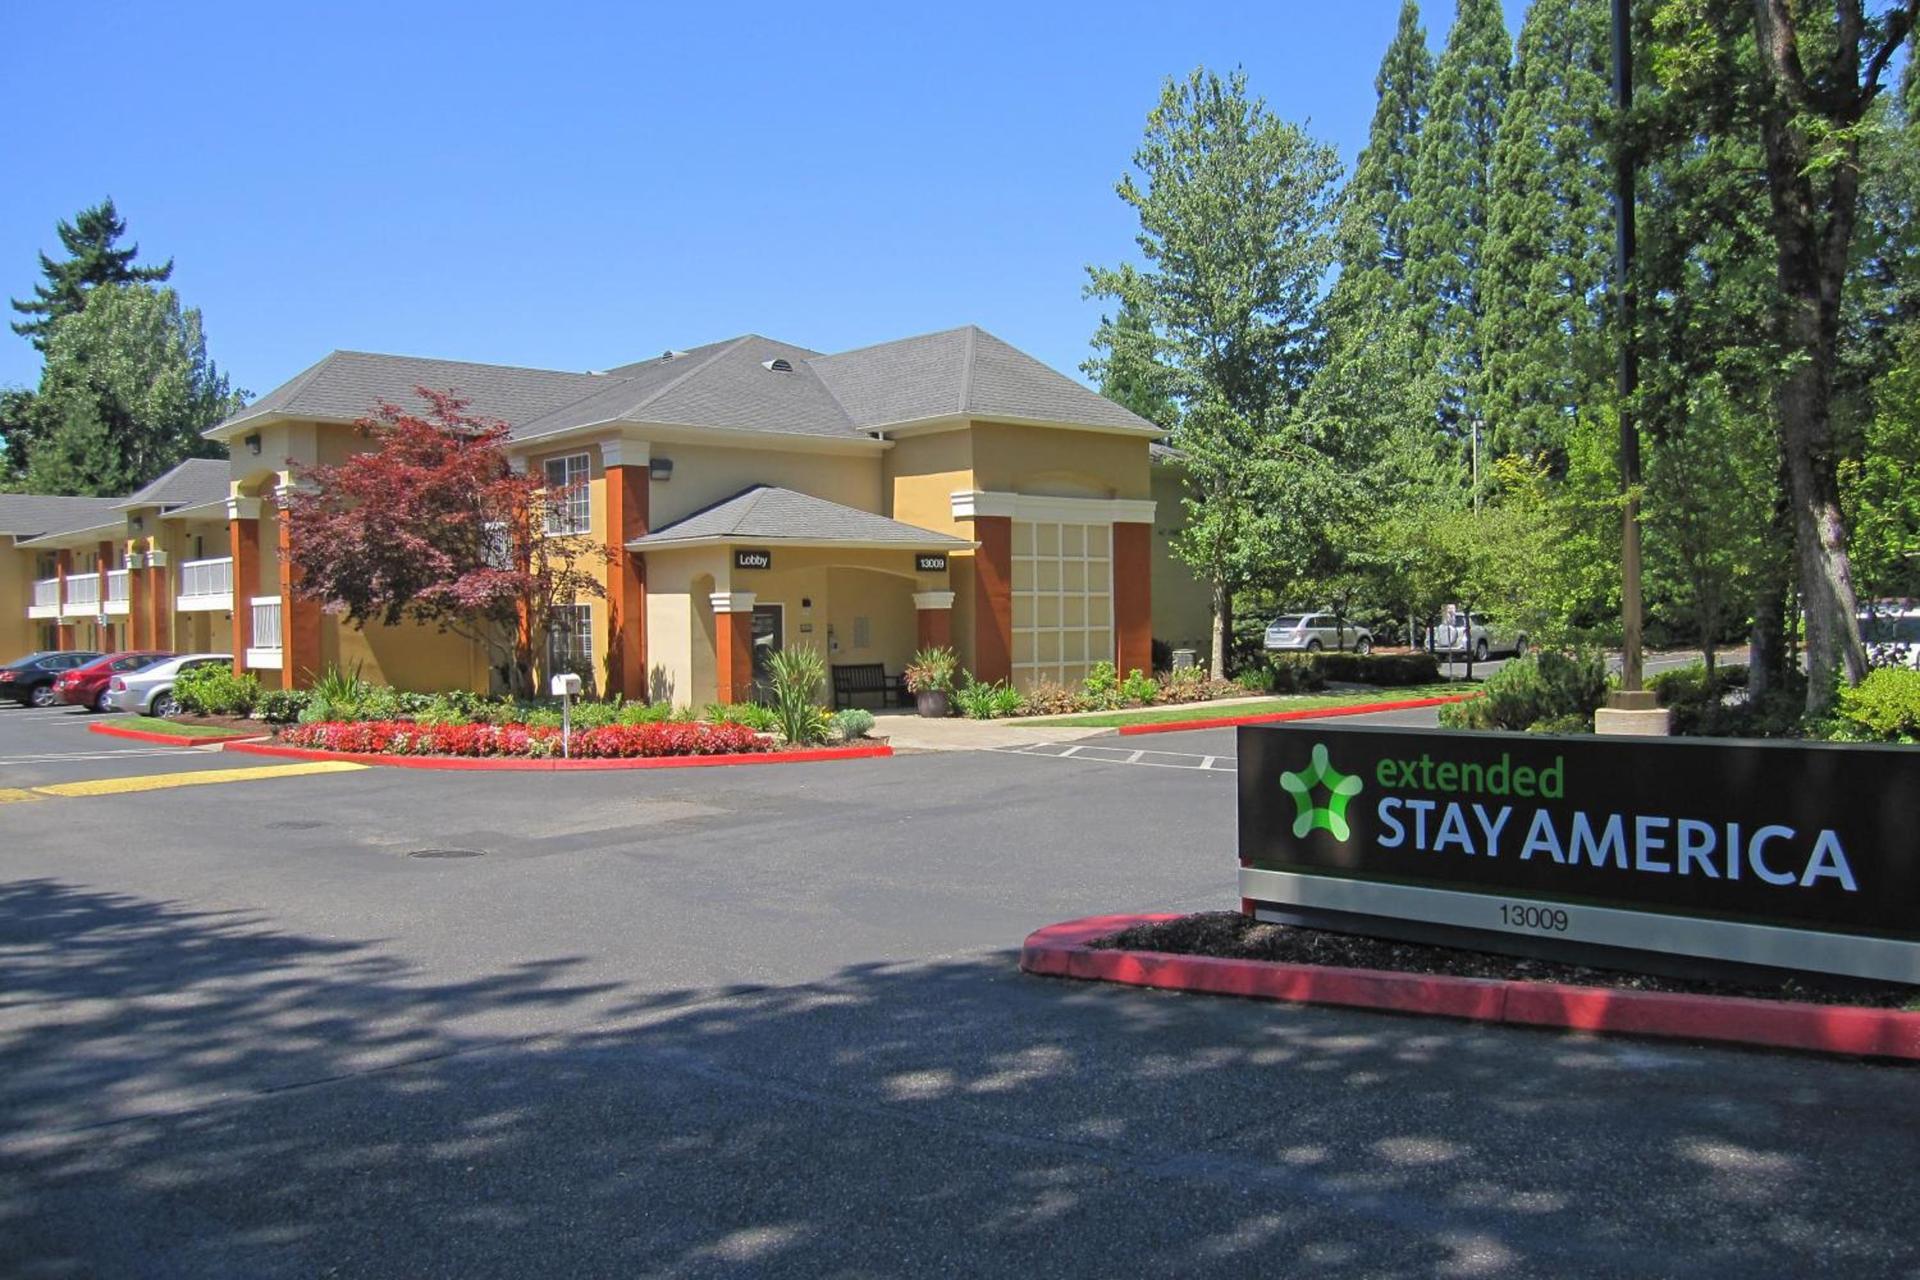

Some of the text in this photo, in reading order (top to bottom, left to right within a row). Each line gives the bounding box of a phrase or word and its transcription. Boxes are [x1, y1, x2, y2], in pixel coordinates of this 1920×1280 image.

[740, 553, 768, 568] Lobby
[920, 558, 944, 569] 13009
[1376, 753, 1564, 798] extended
[1376, 797, 1859, 891] STAY AMERICA
[1500, 904, 1568, 932] 13009
